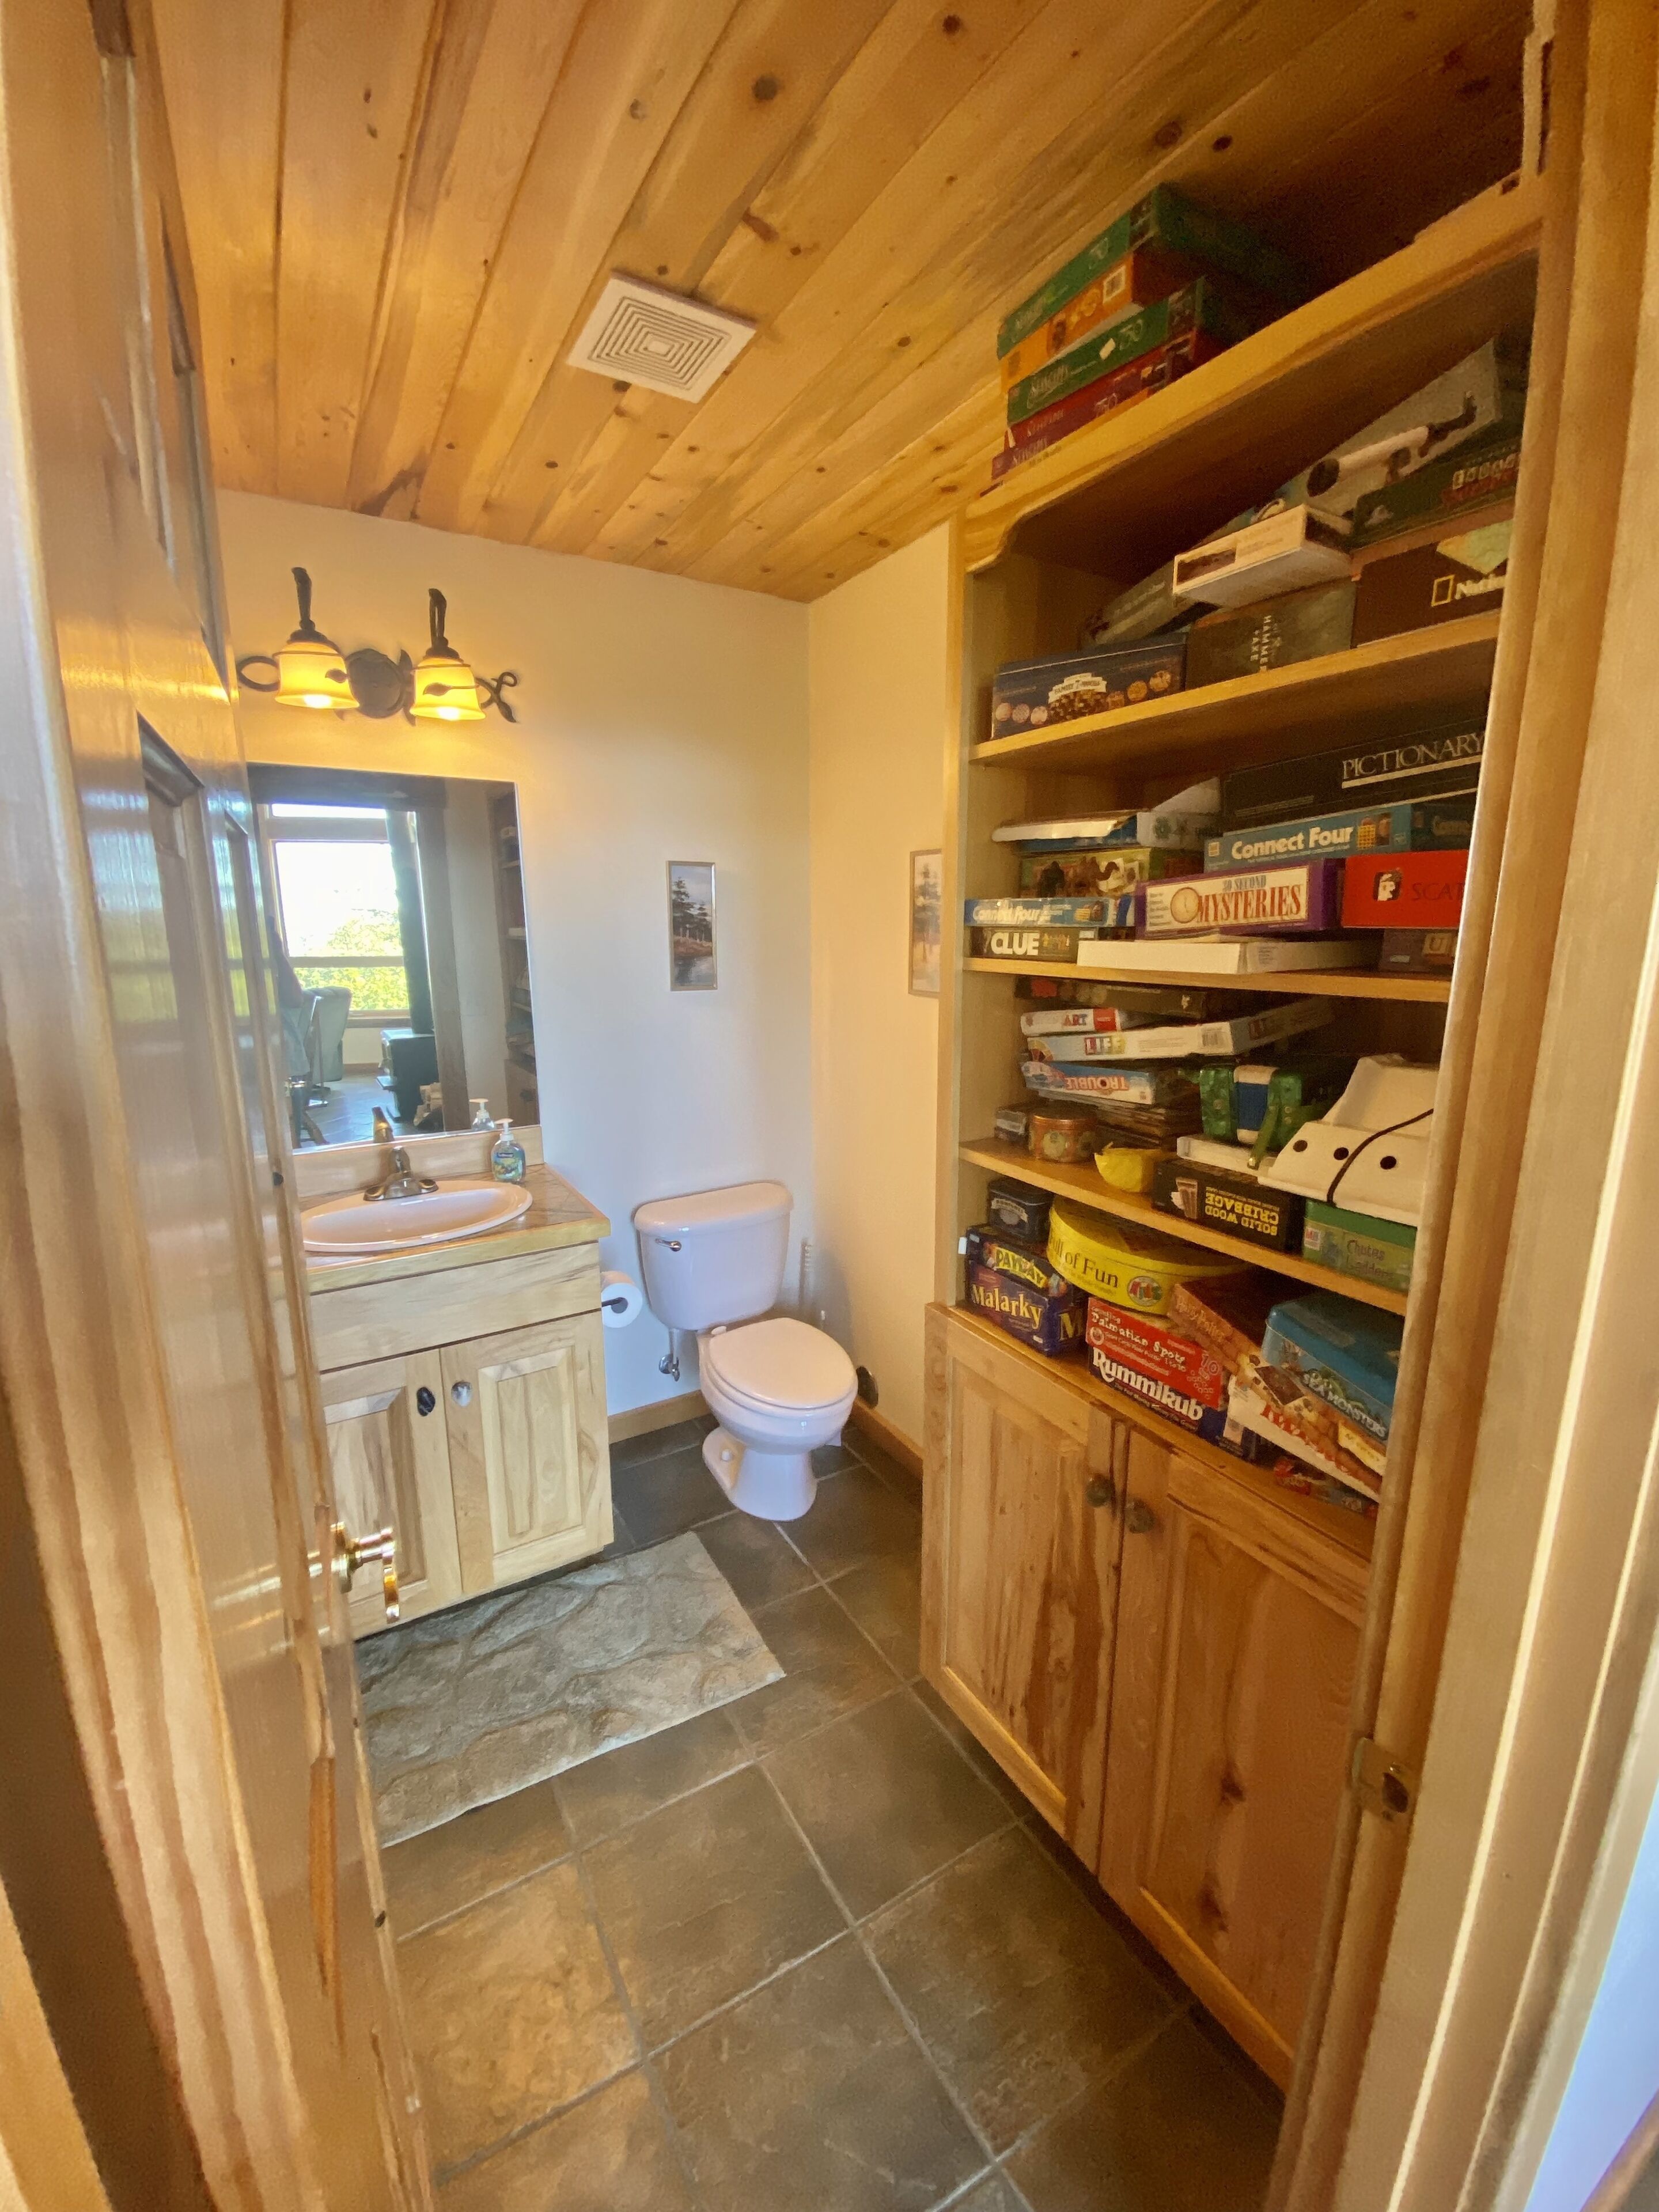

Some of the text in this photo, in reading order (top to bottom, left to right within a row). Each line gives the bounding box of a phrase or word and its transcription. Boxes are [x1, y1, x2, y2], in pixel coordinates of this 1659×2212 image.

[1342, 730, 1485, 779] PICTIONARY
[1232, 831, 1305, 859] Connect
[1309, 827, 1354, 849] Four
[1198, 884, 1302, 922] MYSTERIES
[991, 931, 1040, 956] CLUE
[1085, 1036, 1126, 1056] LIFE
[1066, 1075, 1129, 1090] TROUBLE
[1205, 1192, 1279, 1225] CRIBBAGE
[1205, 1205, 1278, 1236] SOLID WOOD
[1347, 1238, 1386, 1261] Chutes
[1065, 1252, 1081, 1269] of
[1083, 1256, 1119, 1289] Fun
[972, 1283, 1043, 1330] Malarky
[1092, 1346, 1203, 1421] Rummikub
